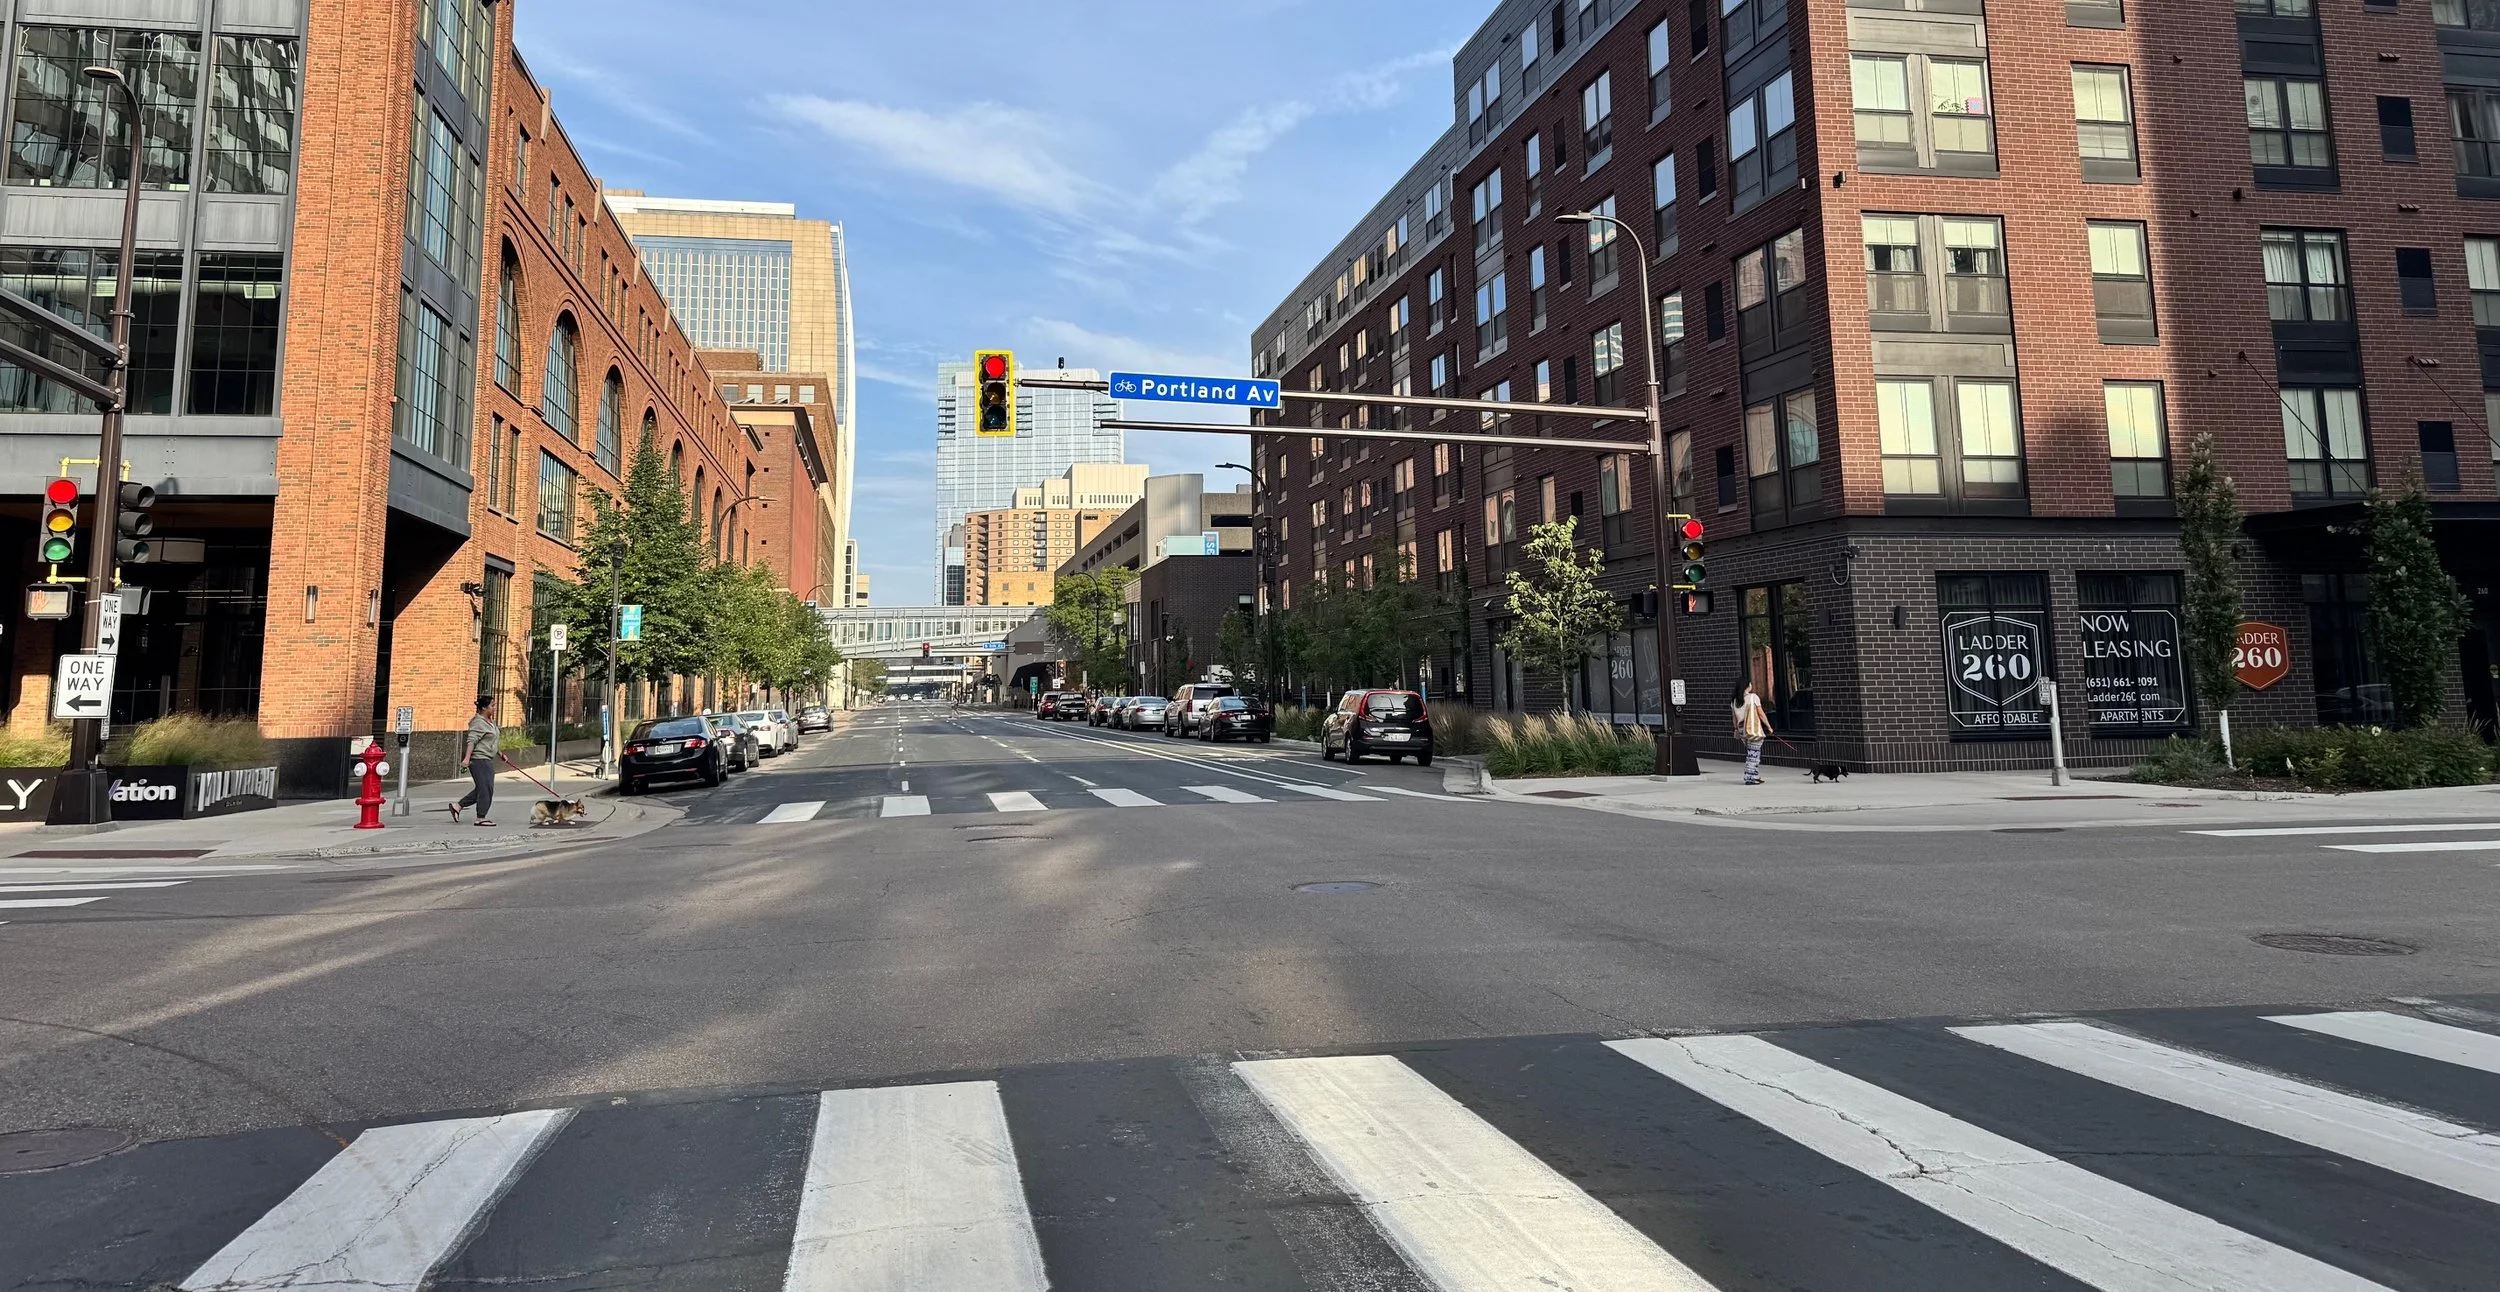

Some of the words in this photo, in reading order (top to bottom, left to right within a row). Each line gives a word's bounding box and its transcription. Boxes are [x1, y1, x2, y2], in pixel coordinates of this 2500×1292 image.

[1141, 379, 1236, 400] Portland
[1246, 385, 1275, 402] Av
[104, 599, 118, 614] ONE
[102, 614, 118, 629] WAY
[2080, 614, 2130, 633] NOW
[1960, 634, 2029, 651] LADDER
[2236, 632, 2280, 645] DDER
[2082, 639, 2172, 659] LEASING
[2230, 646, 2282, 669] 260
[70, 660, 105, 675] ONE
[1611, 658, 1634, 680] 260
[1962, 653, 2031, 681] 260
[66, 677, 105, 692] WAY
[2086, 676, 2111, 688] (651)
[2087, 691, 2161, 702] Ladder260com
[0, 778, 43, 811] Y
[109, 778, 177, 802] ation
